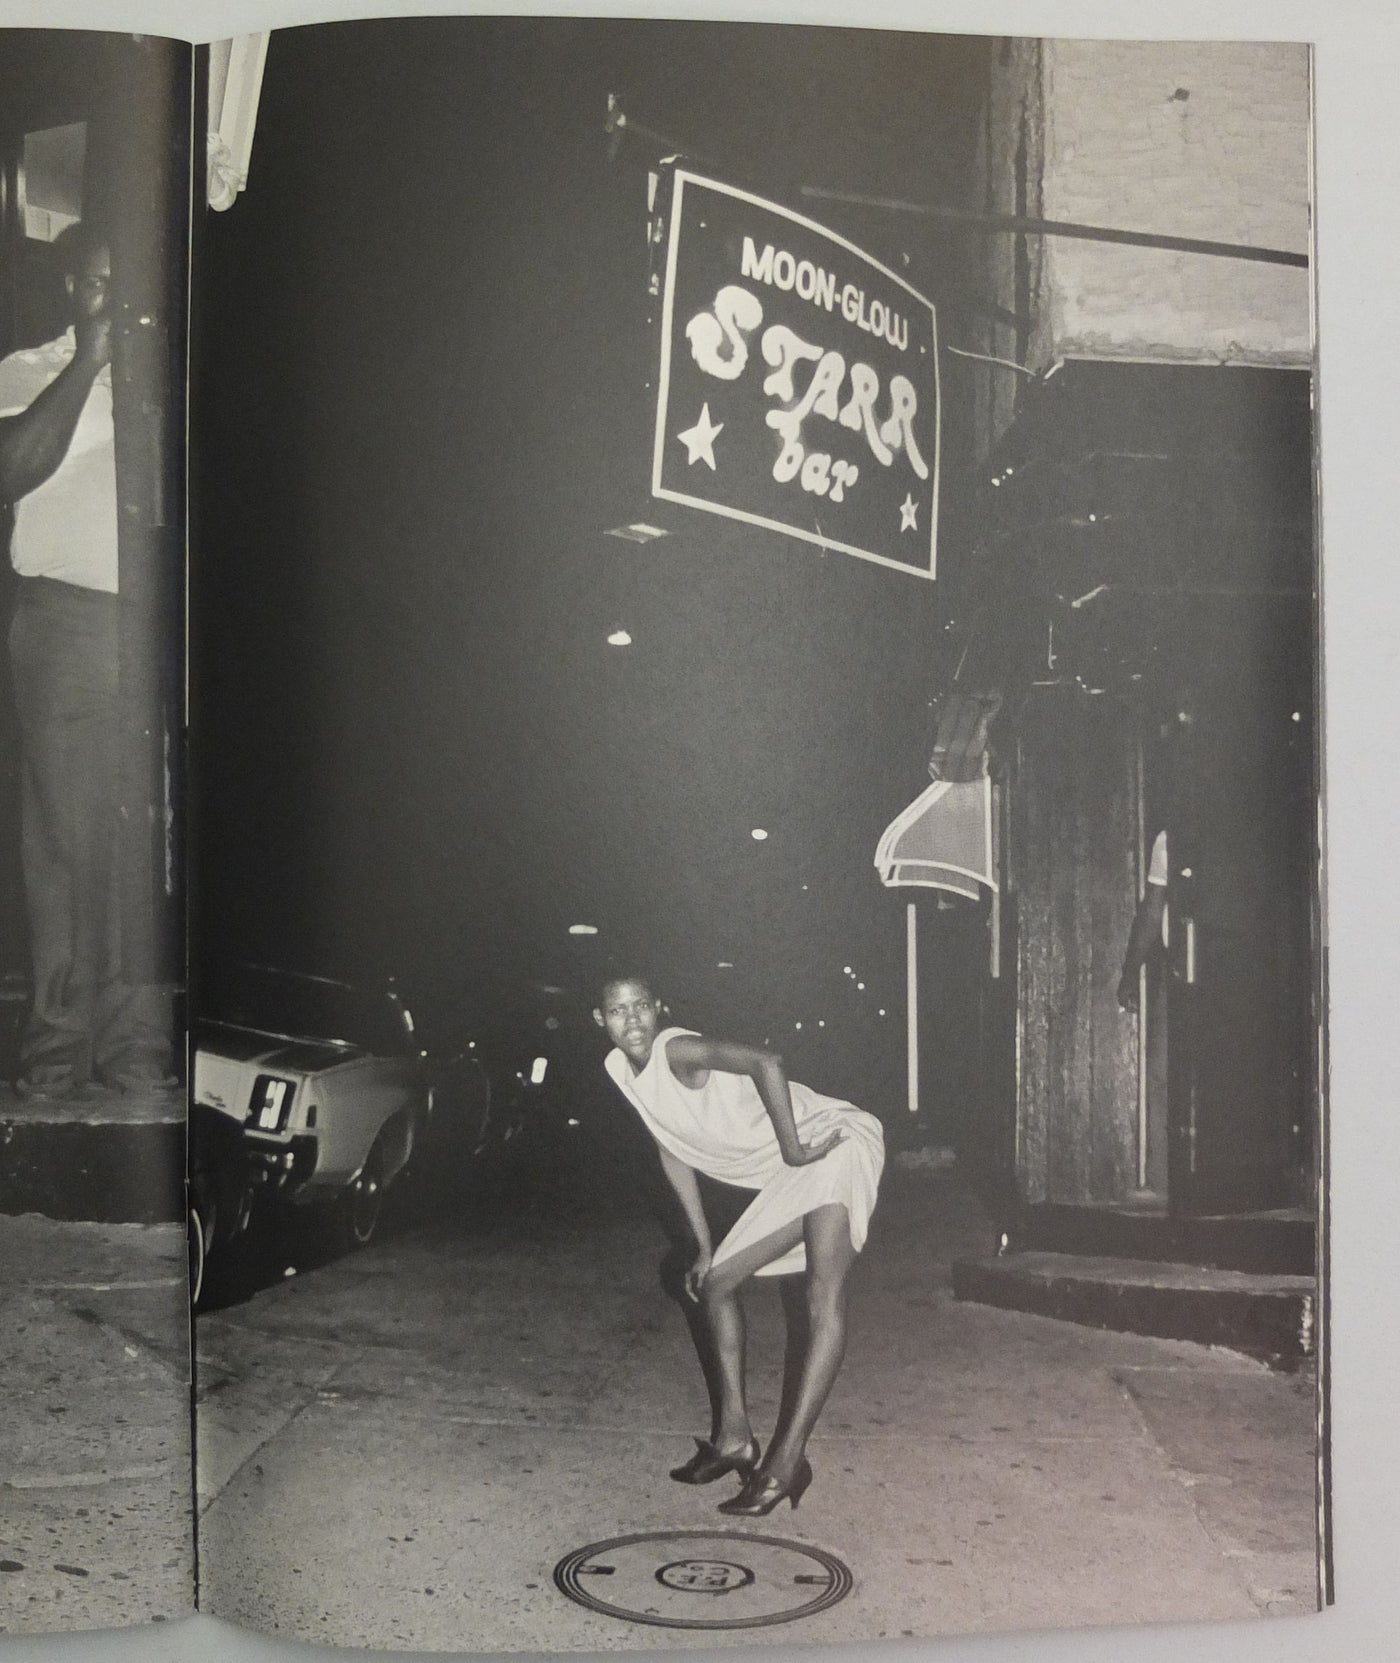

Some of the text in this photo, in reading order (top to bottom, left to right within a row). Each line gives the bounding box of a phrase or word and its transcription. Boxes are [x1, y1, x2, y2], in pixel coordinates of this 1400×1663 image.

[740, 235, 909, 351] MOON-GLOW
[686, 285, 929, 480] STARR
[766, 409, 859, 502] bar
